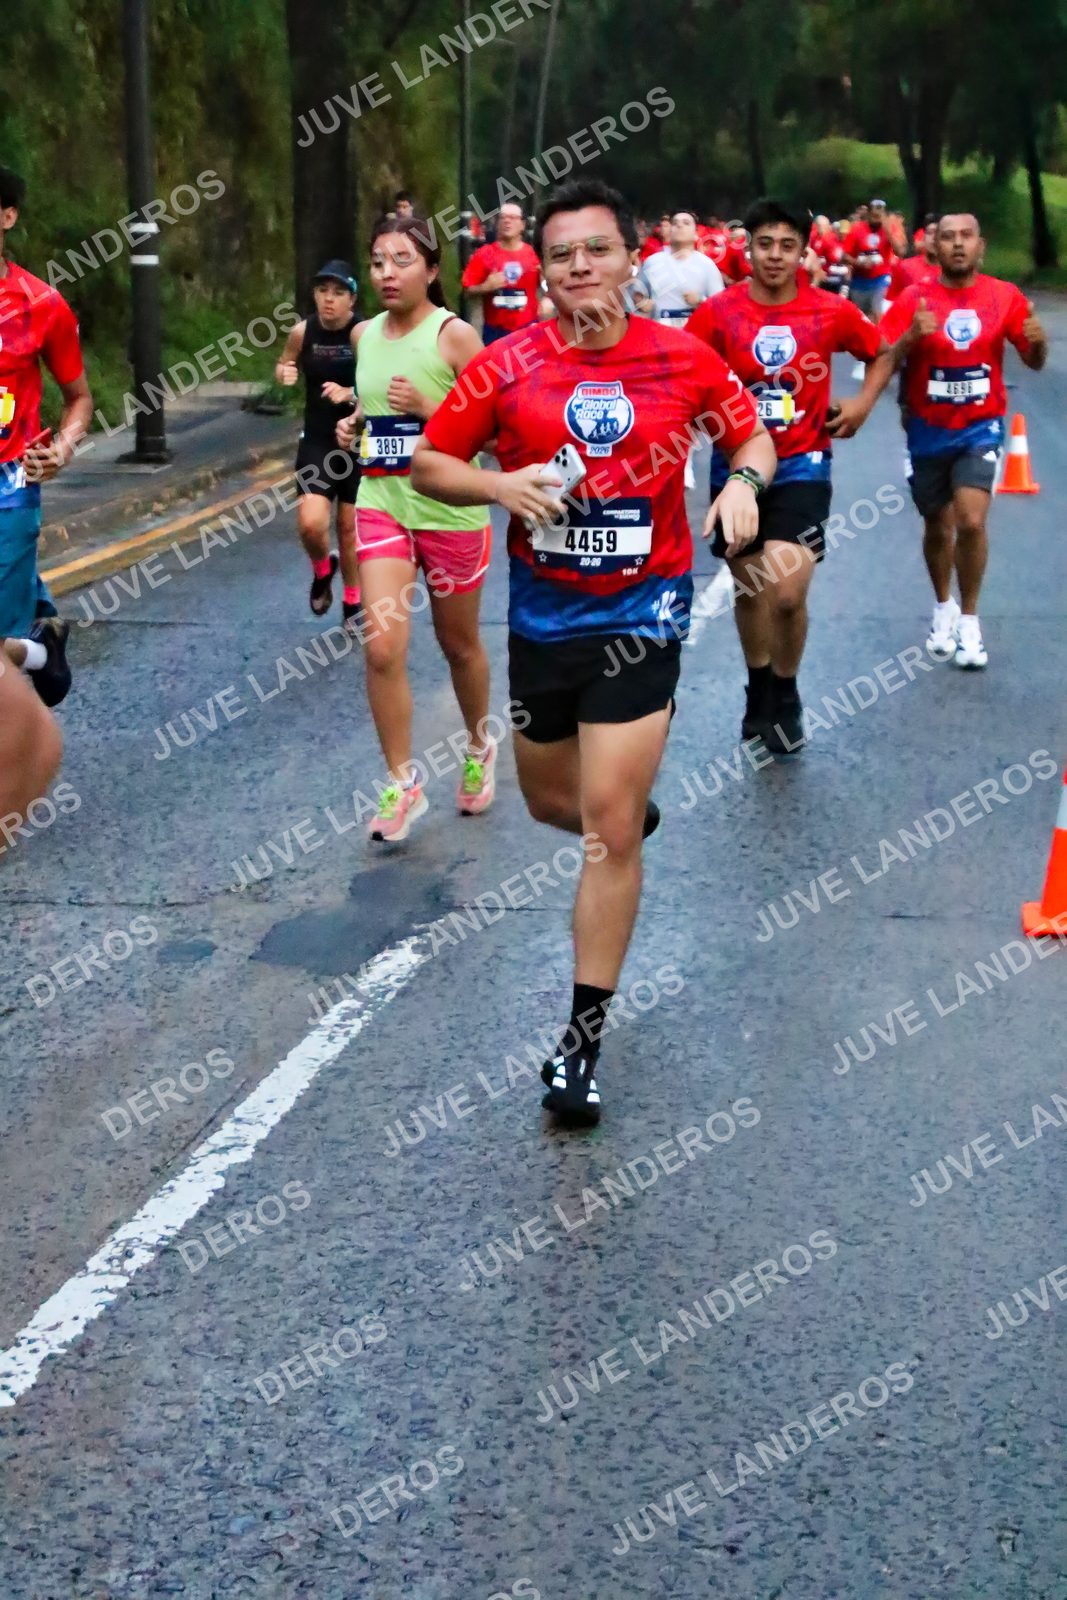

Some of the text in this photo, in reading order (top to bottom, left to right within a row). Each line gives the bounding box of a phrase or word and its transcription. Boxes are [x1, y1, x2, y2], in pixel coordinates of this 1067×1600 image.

[582, 400, 617, 411] Global
[575, 410, 605, 420] Race
[376, 438, 404, 455] 3897
[565, 529, 617, 552] 4459
